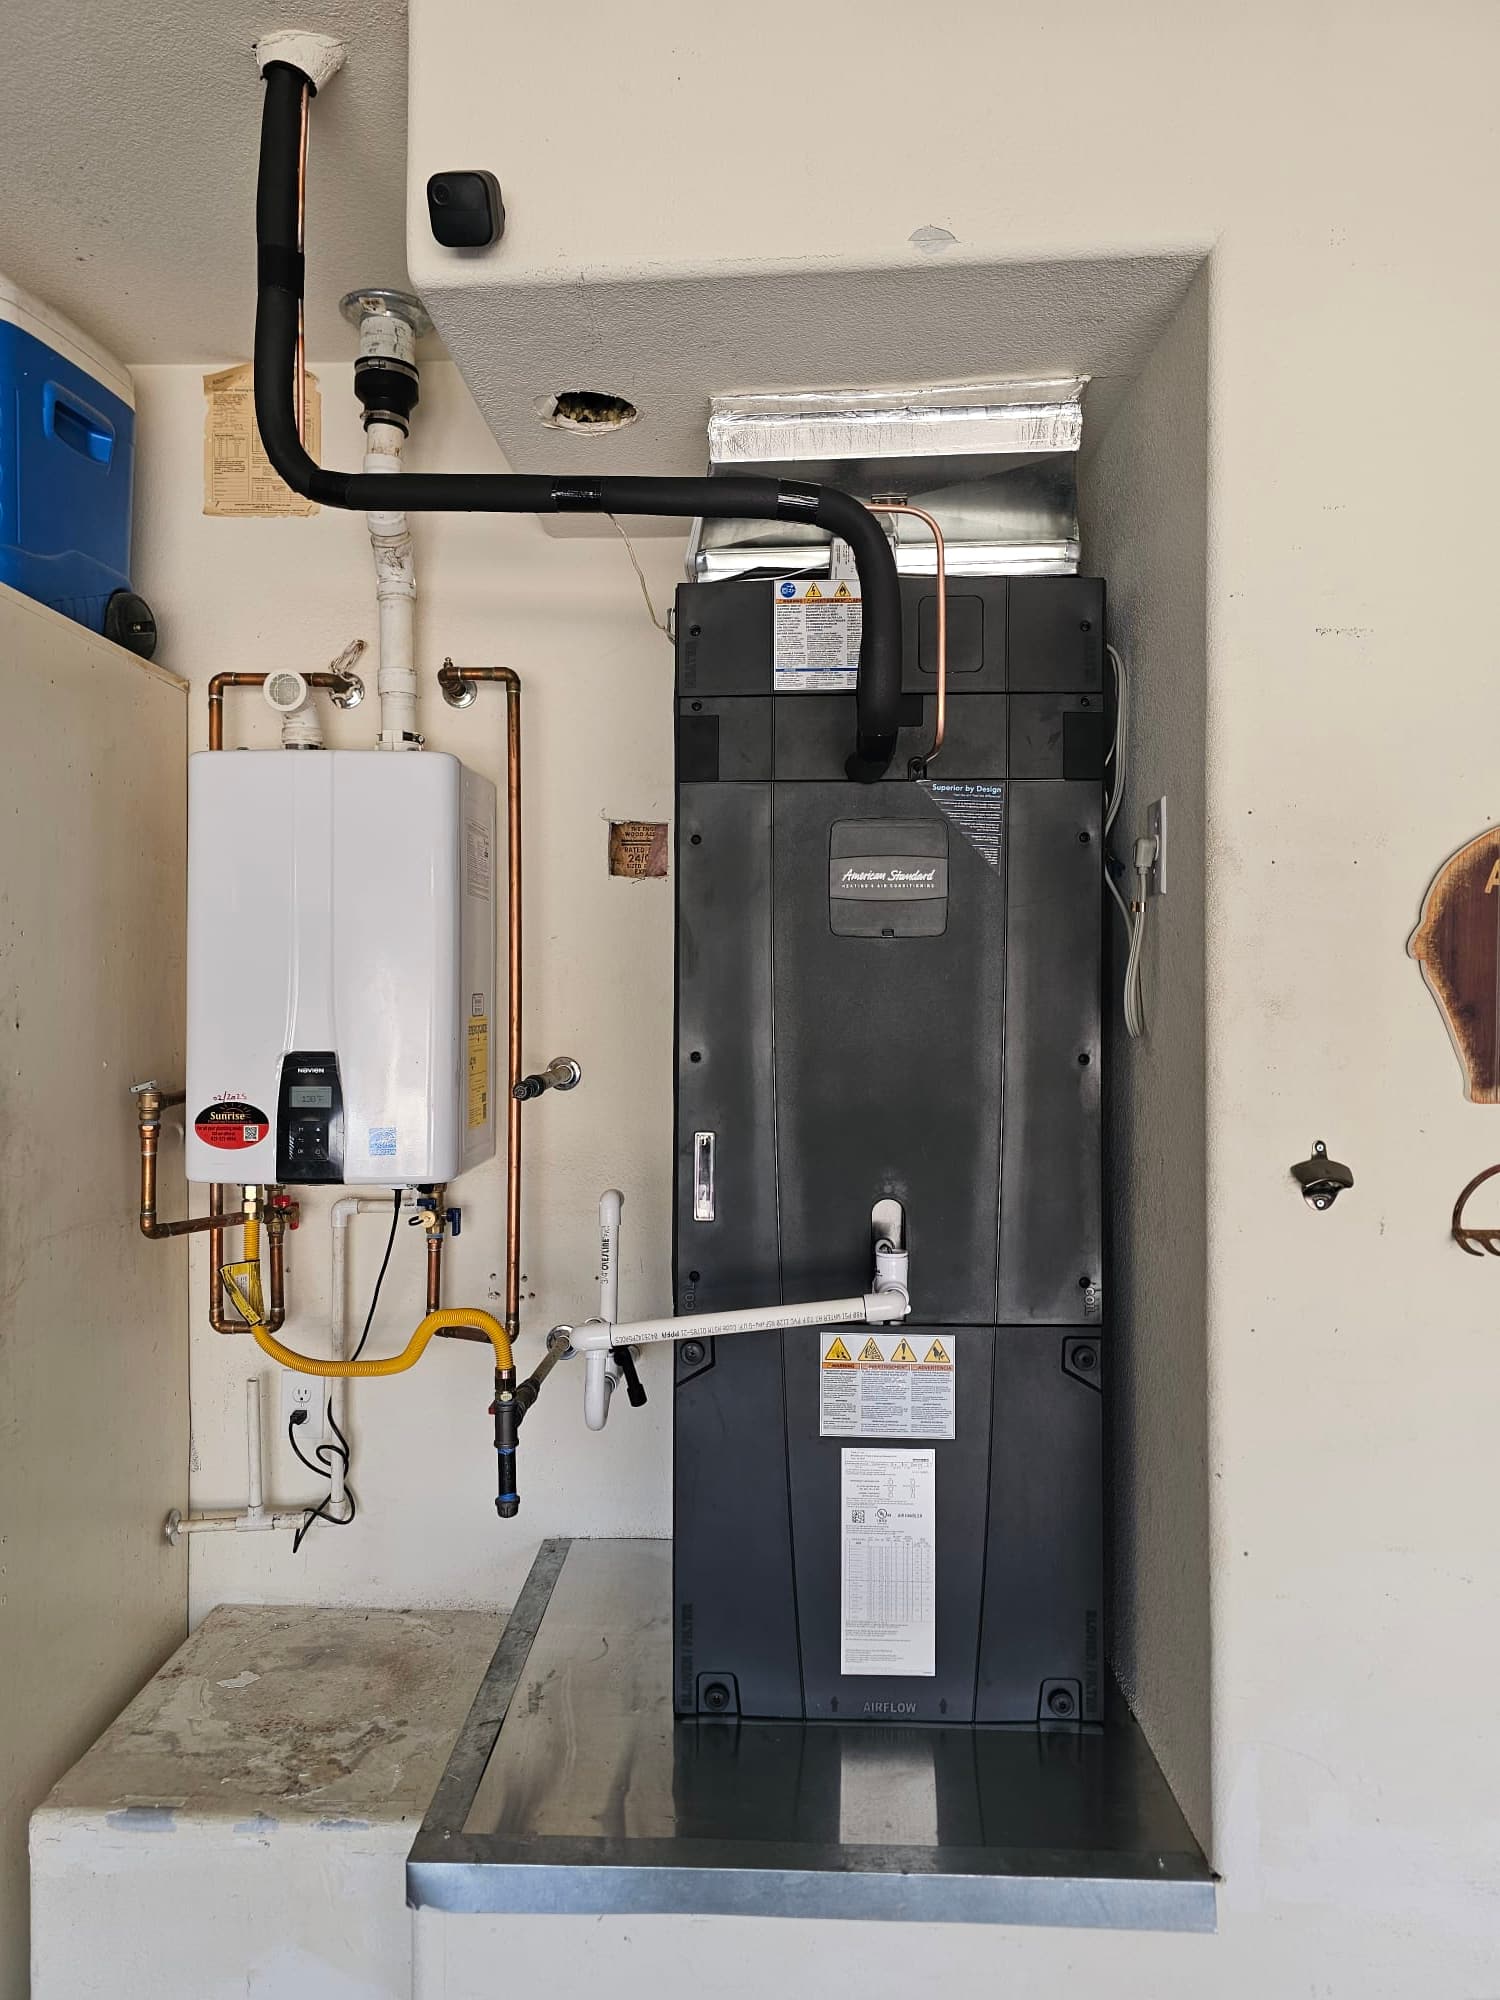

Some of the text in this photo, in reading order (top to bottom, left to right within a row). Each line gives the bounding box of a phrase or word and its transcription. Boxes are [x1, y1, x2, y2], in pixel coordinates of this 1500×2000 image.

[932, 784, 1001, 794] Superior by Design
[842, 869, 936, 881] American Standard
[210, 1111, 246, 1120] Sunrise
[685, 1282, 695, 1310] COIL
[1085, 1288, 1095, 1315] COIL
[864, 1702, 916, 1713] AIRFLOW
